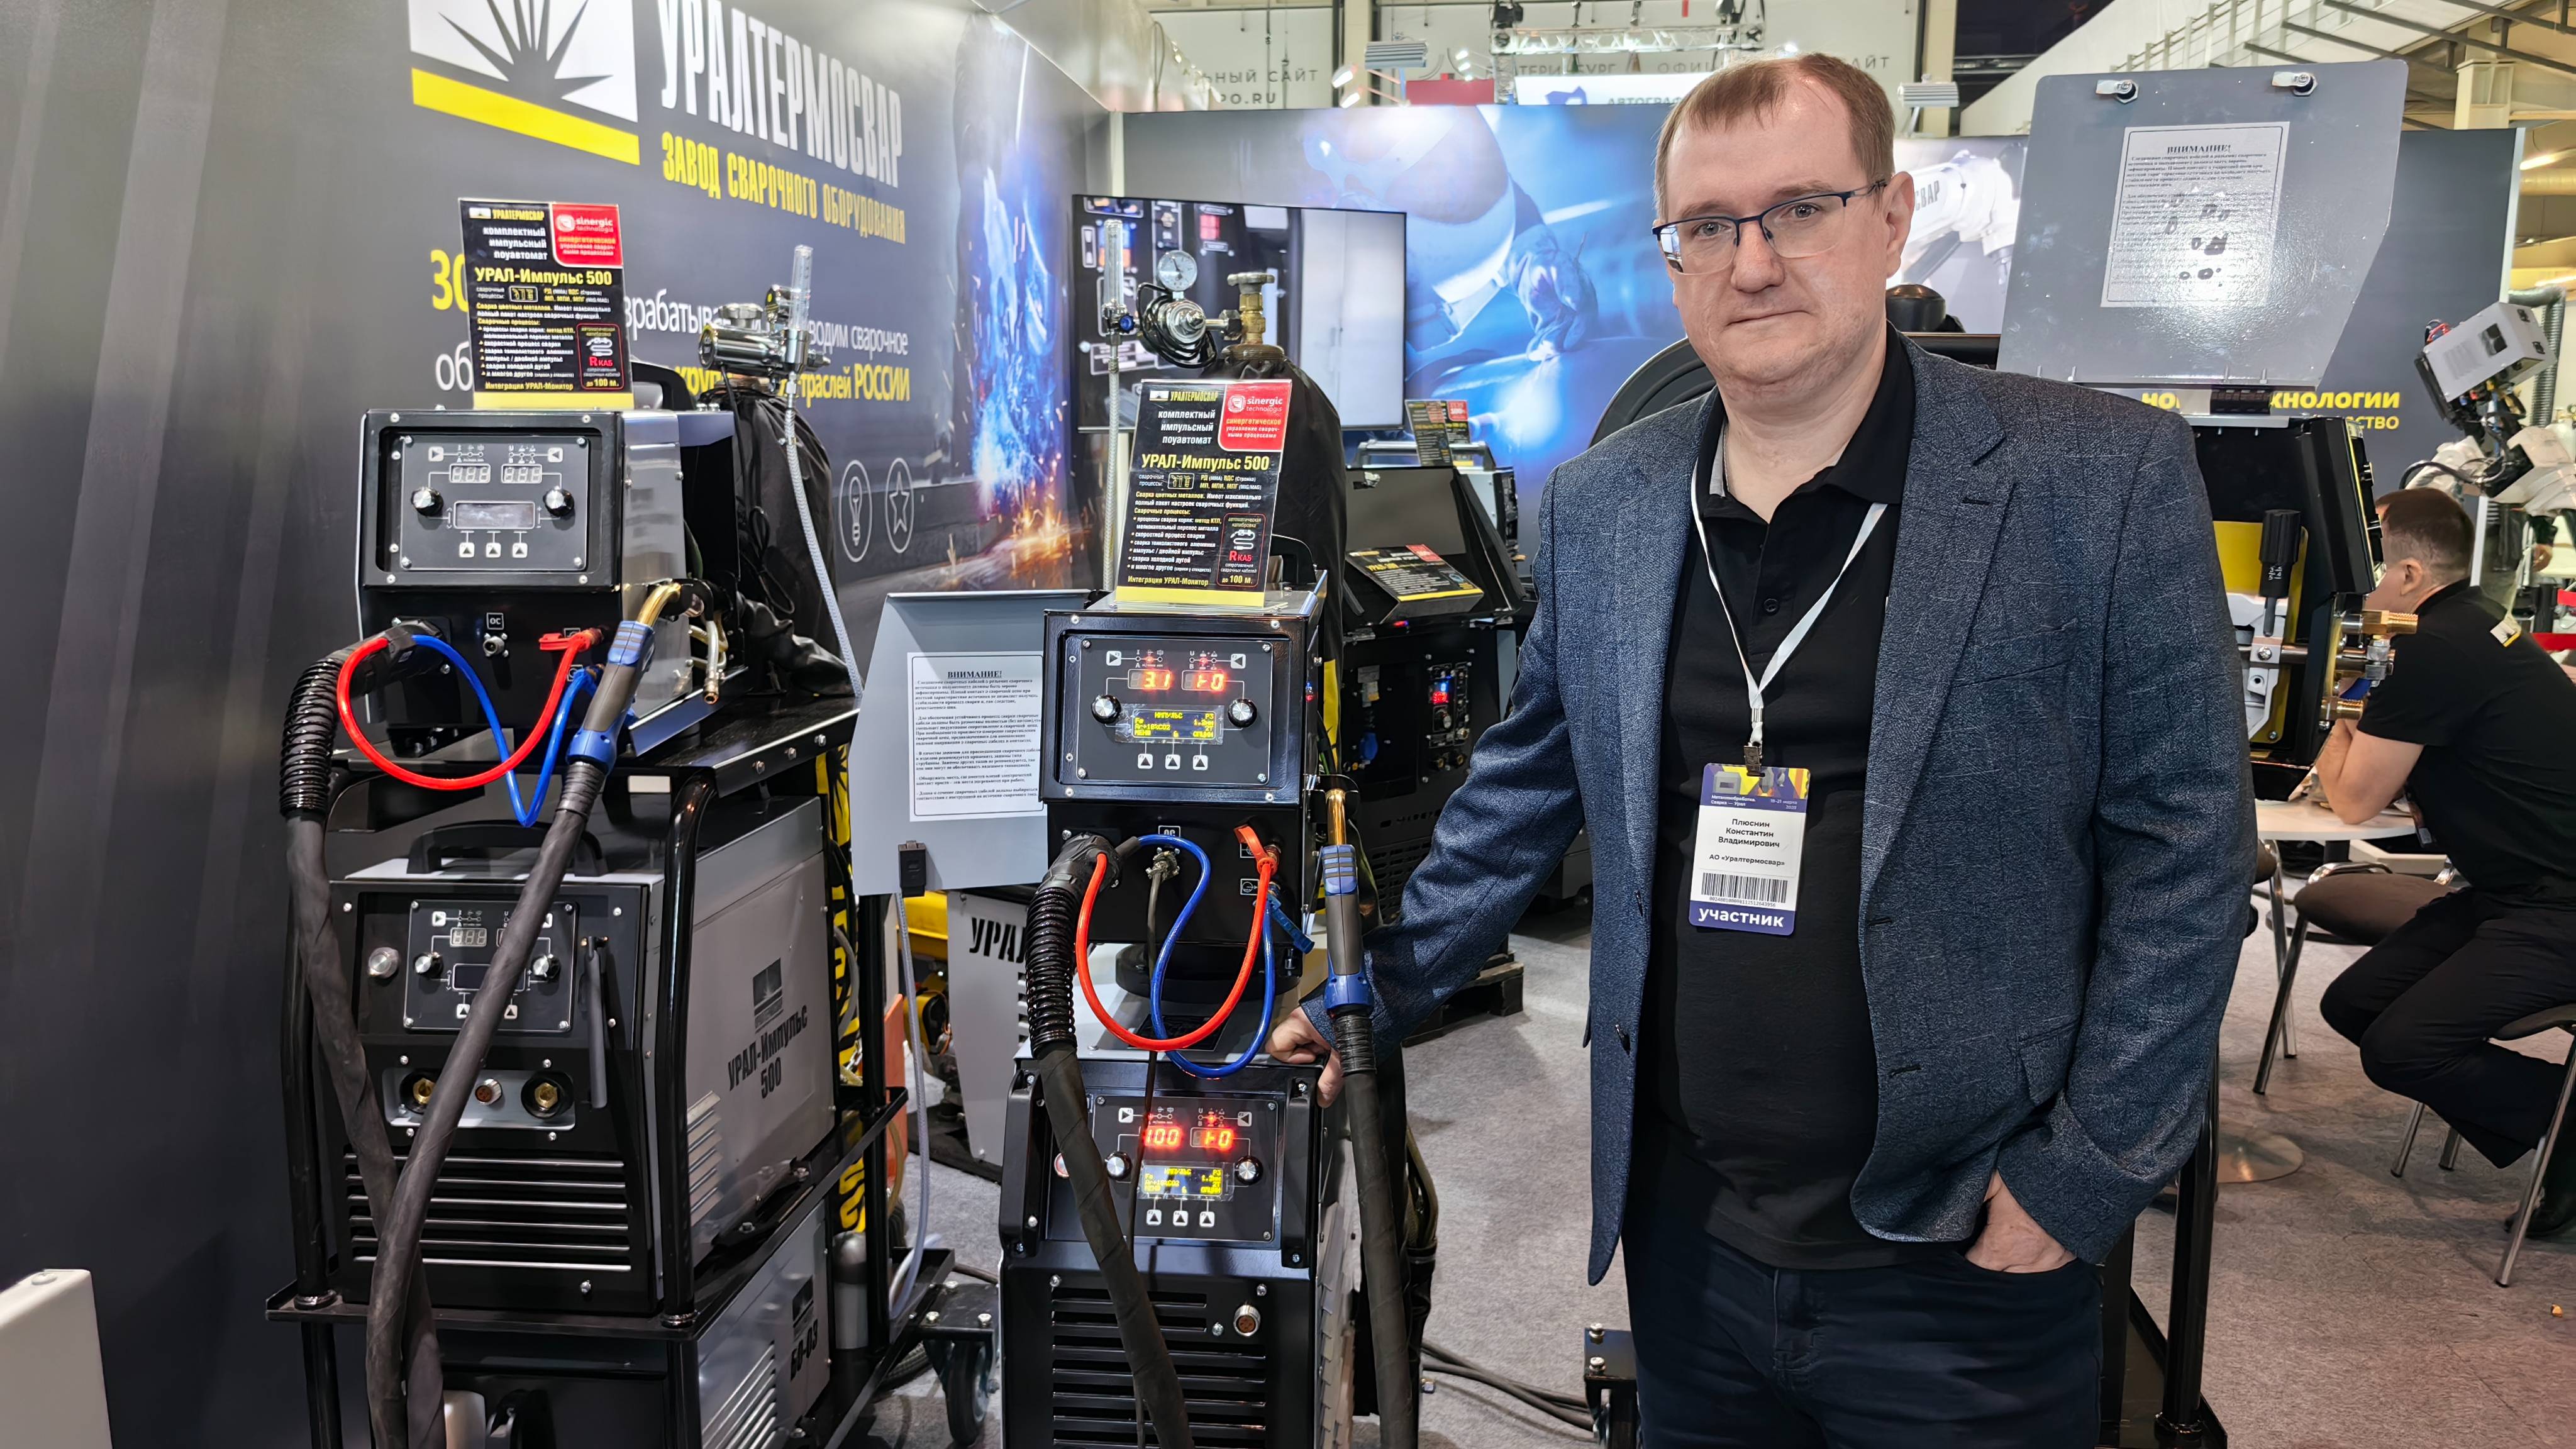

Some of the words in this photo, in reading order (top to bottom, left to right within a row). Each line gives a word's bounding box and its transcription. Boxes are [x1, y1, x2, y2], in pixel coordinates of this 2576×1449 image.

[1268, 68, 1318, 82] САЙТ
[657, 0, 902, 188] УРАЛТЕРМОСВАР
[662, 131, 721, 199] ЗАВОД
[726, 152, 818, 219] СВАРОЧНОГО
[822, 183, 906, 244] ОБОРУДОВАНИЯ
[575, 216, 613, 227] sinergic
[483, 227, 546, 236] комплектный
[489, 238, 547, 249] импульсный
[494, 250, 548, 262] поуавтомат
[474, 267, 584, 286] УРАЛ-Импульс
[586, 270, 612, 285] 500
[851, 323, 908, 360] сварочное
[594, 378, 608, 387] 100
[855, 362, 910, 401] РОССИИ
[1170, 391, 1218, 402] УРАЛТЕРМОСВАР
[1246, 396, 1283, 407] sinergic
[1158, 410, 1216, 419] комплектный
[1160, 422, 1214, 433] импульсный
[1226, 418, 1282, 426] синергетическое
[1162, 436, 1212, 445] поуавтомат
[1141, 454, 1242, 472] УРАЛ-Импульс
[1244, 456, 1270, 470] 500
[1128, 575, 1163, 585] Интеграция
[1163, 577, 1209, 587] УРАЛ-Монитор
[1230, 575, 1243, 584] 100
[947, 670, 1002, 679] ВНИМАНИЕ!
[1731, 819, 1770, 828] Плюснин
[1725, 828, 1774, 838] Константин
[1718, 836, 1780, 848] Владимирович
[1721, 855, 1785, 867] «Уралтермосвар»
[1698, 908, 1784, 928] участник
[728, 1004, 808, 1092] УРАЛ-Импульс
[760, 1057, 782, 1099] 500
[1145, 1128, 1179, 1145] 100
